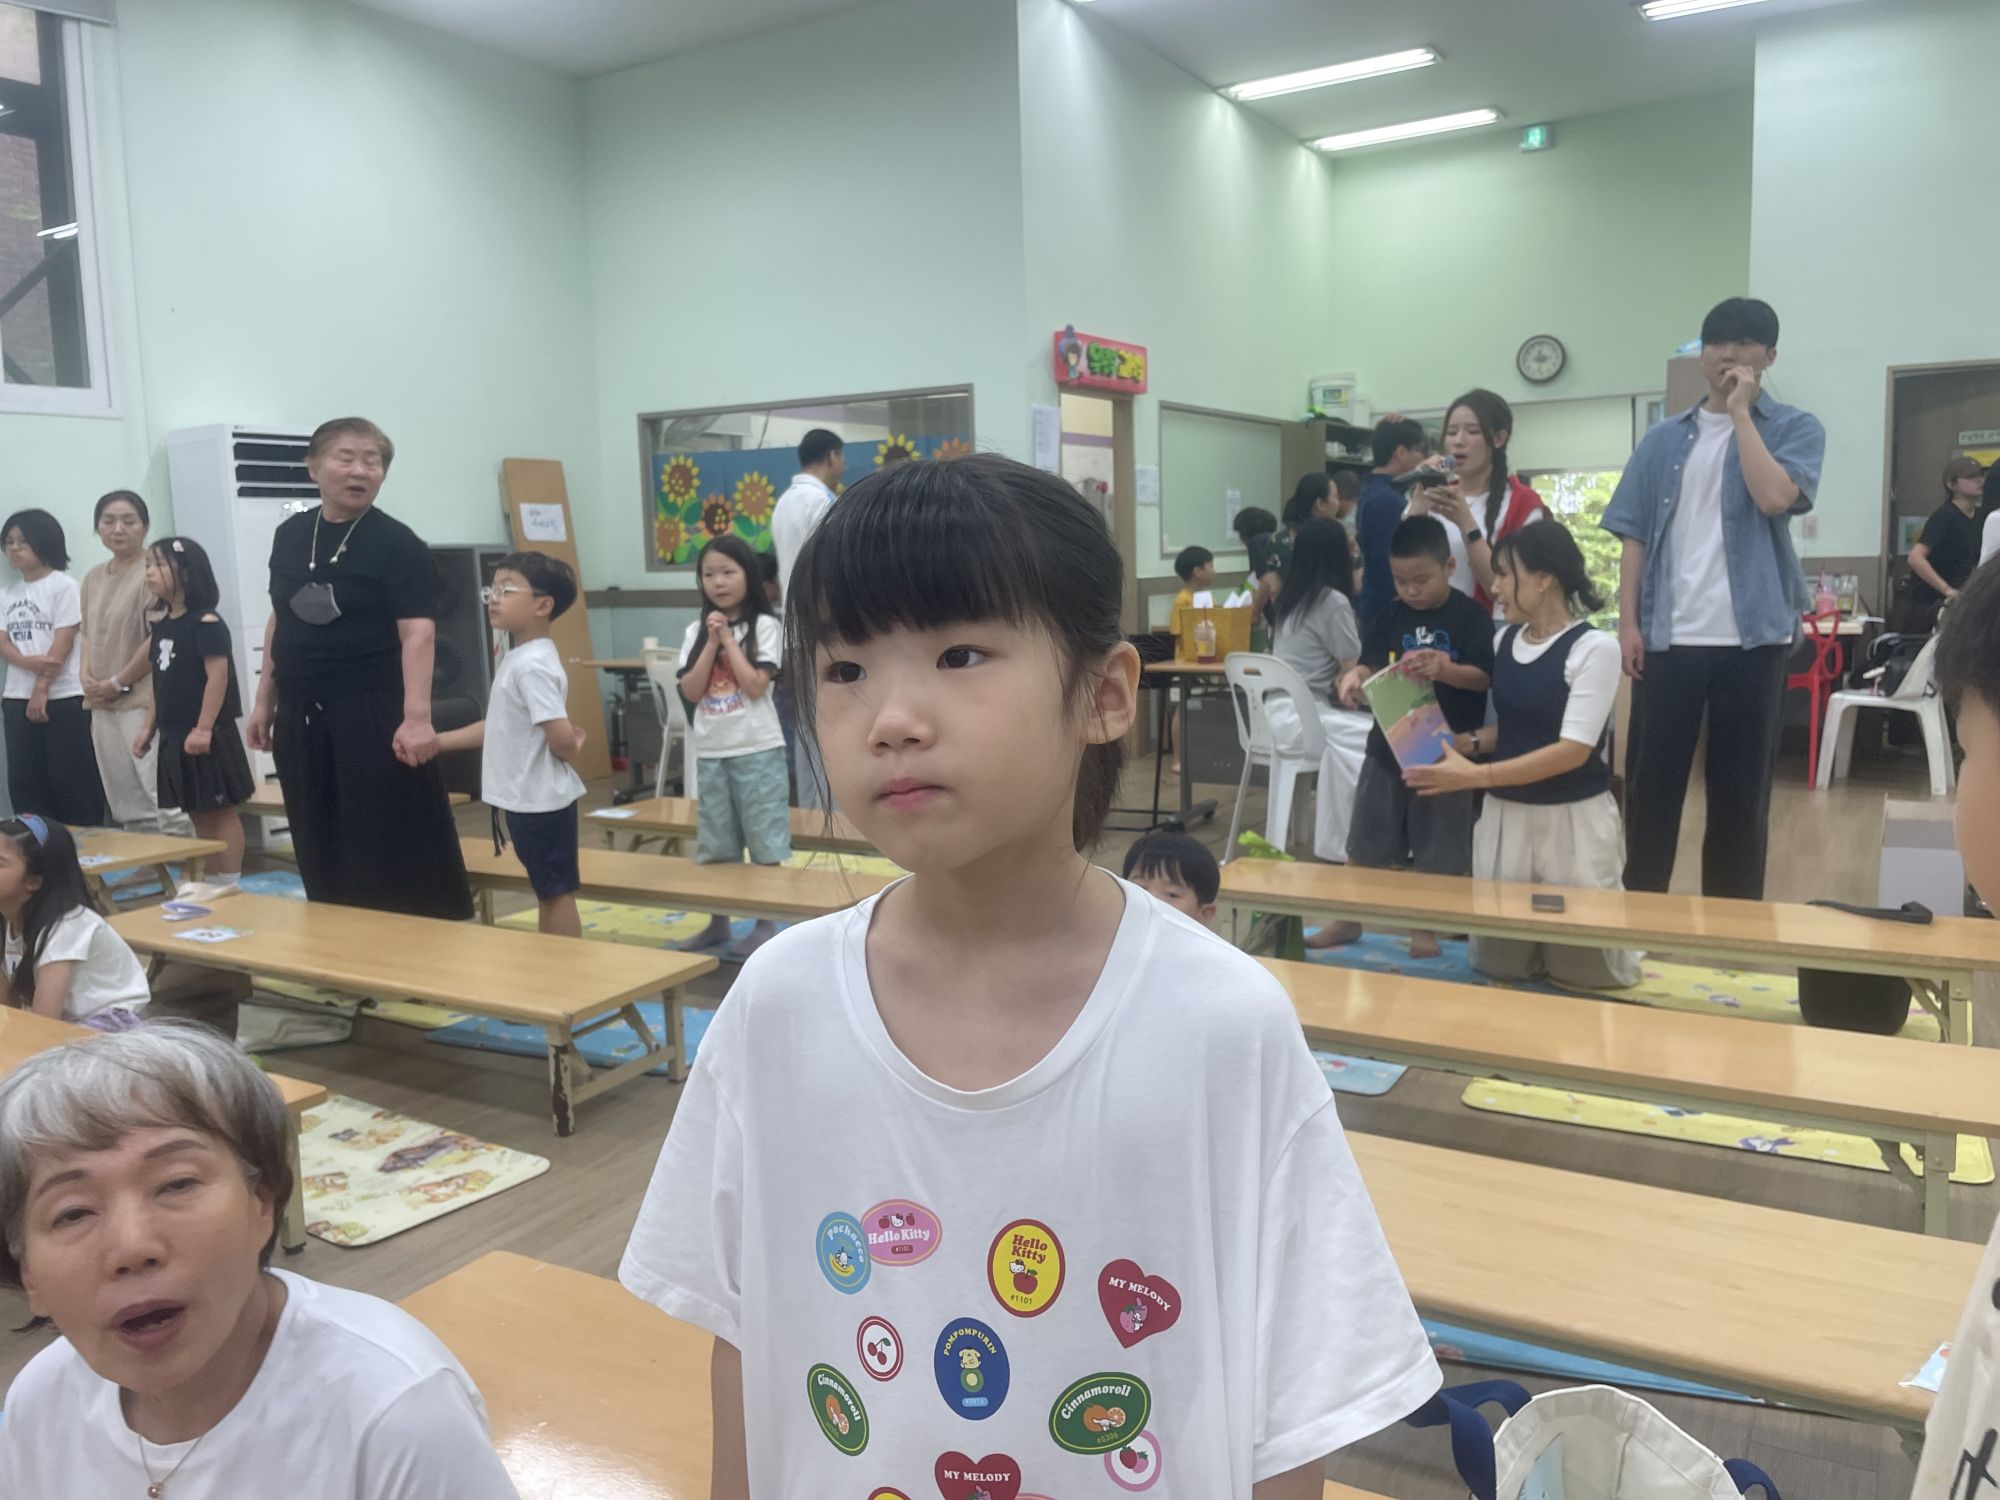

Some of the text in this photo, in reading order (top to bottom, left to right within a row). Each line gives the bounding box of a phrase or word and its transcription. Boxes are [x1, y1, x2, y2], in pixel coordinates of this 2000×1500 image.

[868, 1228, 930, 1245] Hello Kitty
[1012, 1234, 1048, 1251] Hello
[1011, 1246, 1046, 1264] Kitty
[1010, 1294, 1033, 1305] #1101
[1108, 1276, 1172, 1311] MY MELODY
[943, 1328, 997, 1356] POMPOMPURIN
[817, 1373, 861, 1421] Cinnamoroll
[1061, 1384, 1132, 1419] Cinnamoroll
[944, 1469, 1011, 1482] MY MELODY
